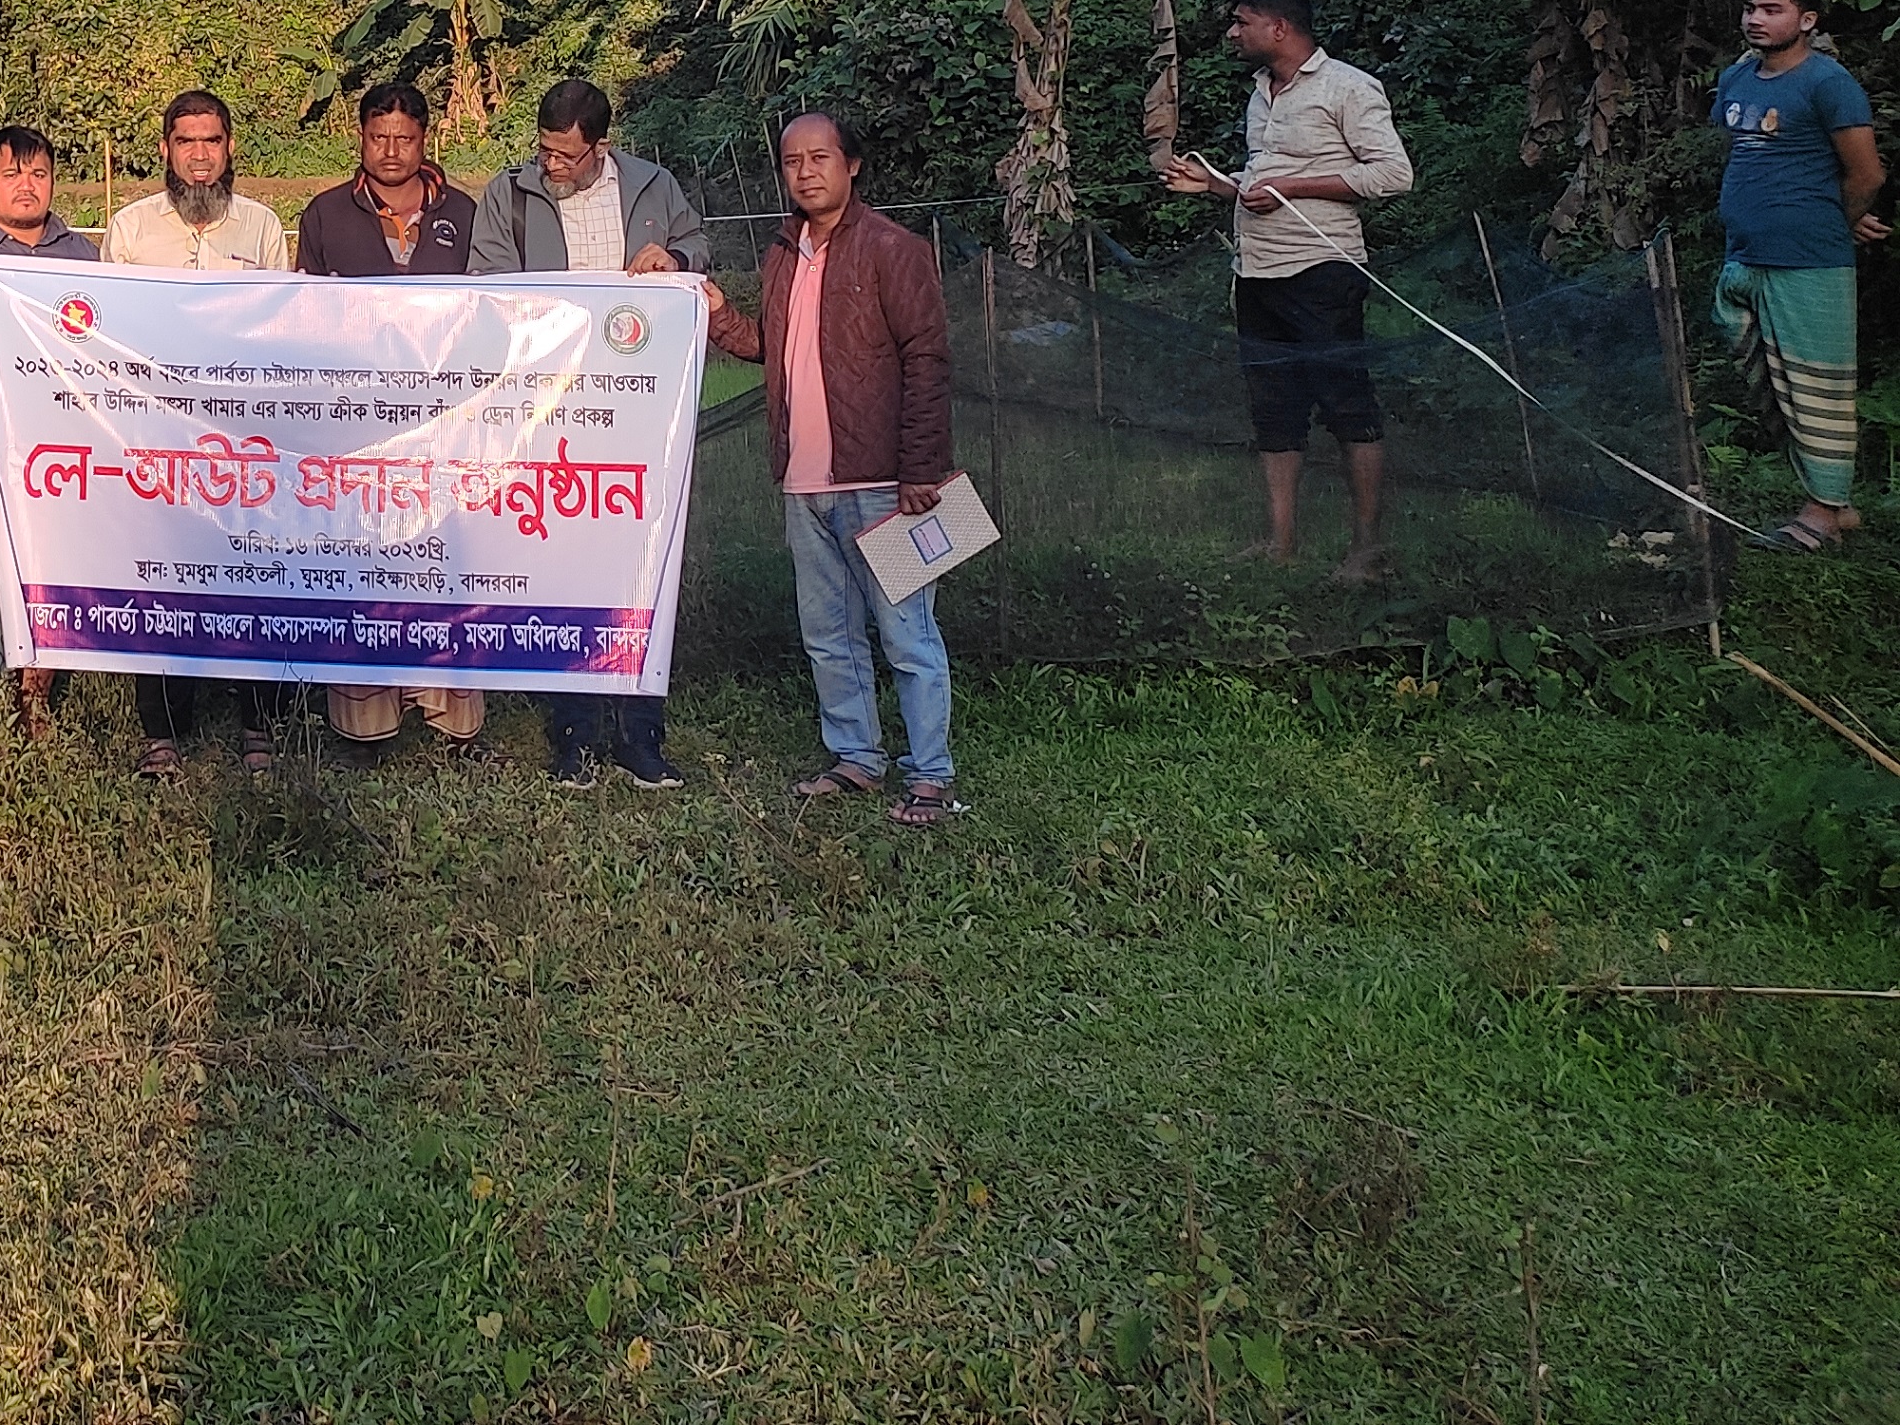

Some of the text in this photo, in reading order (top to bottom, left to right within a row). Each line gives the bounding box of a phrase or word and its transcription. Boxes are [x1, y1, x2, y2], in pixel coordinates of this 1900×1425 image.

[205, 360, 257, 385] পার্বত্য
[590, 372, 658, 395] আওতায়
[201, 395, 248, 419] খামার
[251, 400, 278, 419] এর
[280, 400, 324, 421] মৎস্য
[327, 395, 369, 422] ক্রীক
[372, 396, 423, 425] উন্নয়ন
[571, 405, 615, 428] প্রকল্প
[23, 433, 649, 541] লে-আউট প্রদান অনুষ্ঠান
[285, 536, 308, 555] ১৬
[172, 562, 219, 587] ঘুমধুম
[458, 572, 529, 594] বান্দরবান
[142, 599, 196, 638] চট্টগ্রাম
[199, 609, 255, 641] অঞ্চলে
[257, 614, 347, 645] মৎস্যসম্পদ
[351, 609, 403, 651] উন্নয়ন
[463, 621, 508, 653] মৎস্য
